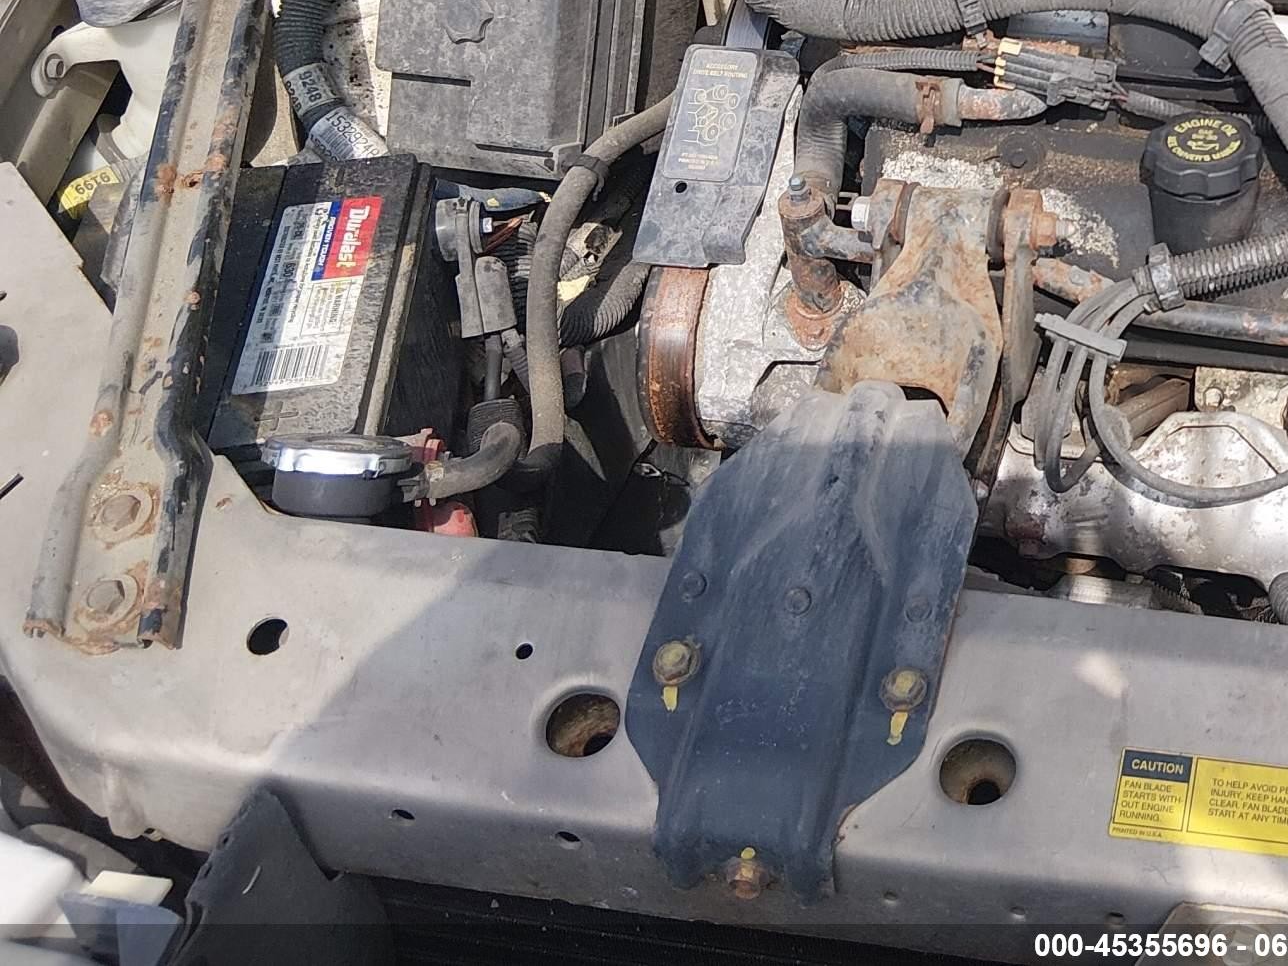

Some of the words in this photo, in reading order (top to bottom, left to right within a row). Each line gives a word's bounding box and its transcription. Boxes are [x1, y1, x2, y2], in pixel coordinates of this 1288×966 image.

[299, 70, 322, 103] 9248
[1174, 118, 1223, 133] ENGINE
[336, 205, 371, 268] Duralast
[1131, 759, 1184, 774] CAUTION
[1124, 780, 1141, 789] FAN
[1143, 782, 1172, 792] BLADE
[1212, 778, 1224, 786] TO
[1226, 780, 1248, 789] HELP
[1250, 783, 1277, 793] AVOID
[1122, 790, 1156, 801] STARTS
[1246, 792, 1269, 803] KEEP
[1121, 800, 1139, 808] OUT
[1141, 802, 1175, 813] ENGINE
[1242, 801, 1260, 812] FAN
[1208, 808, 1236, 818] START
[1238, 811, 1249, 820] AT
[1251, 813, 1270, 823] ANY
